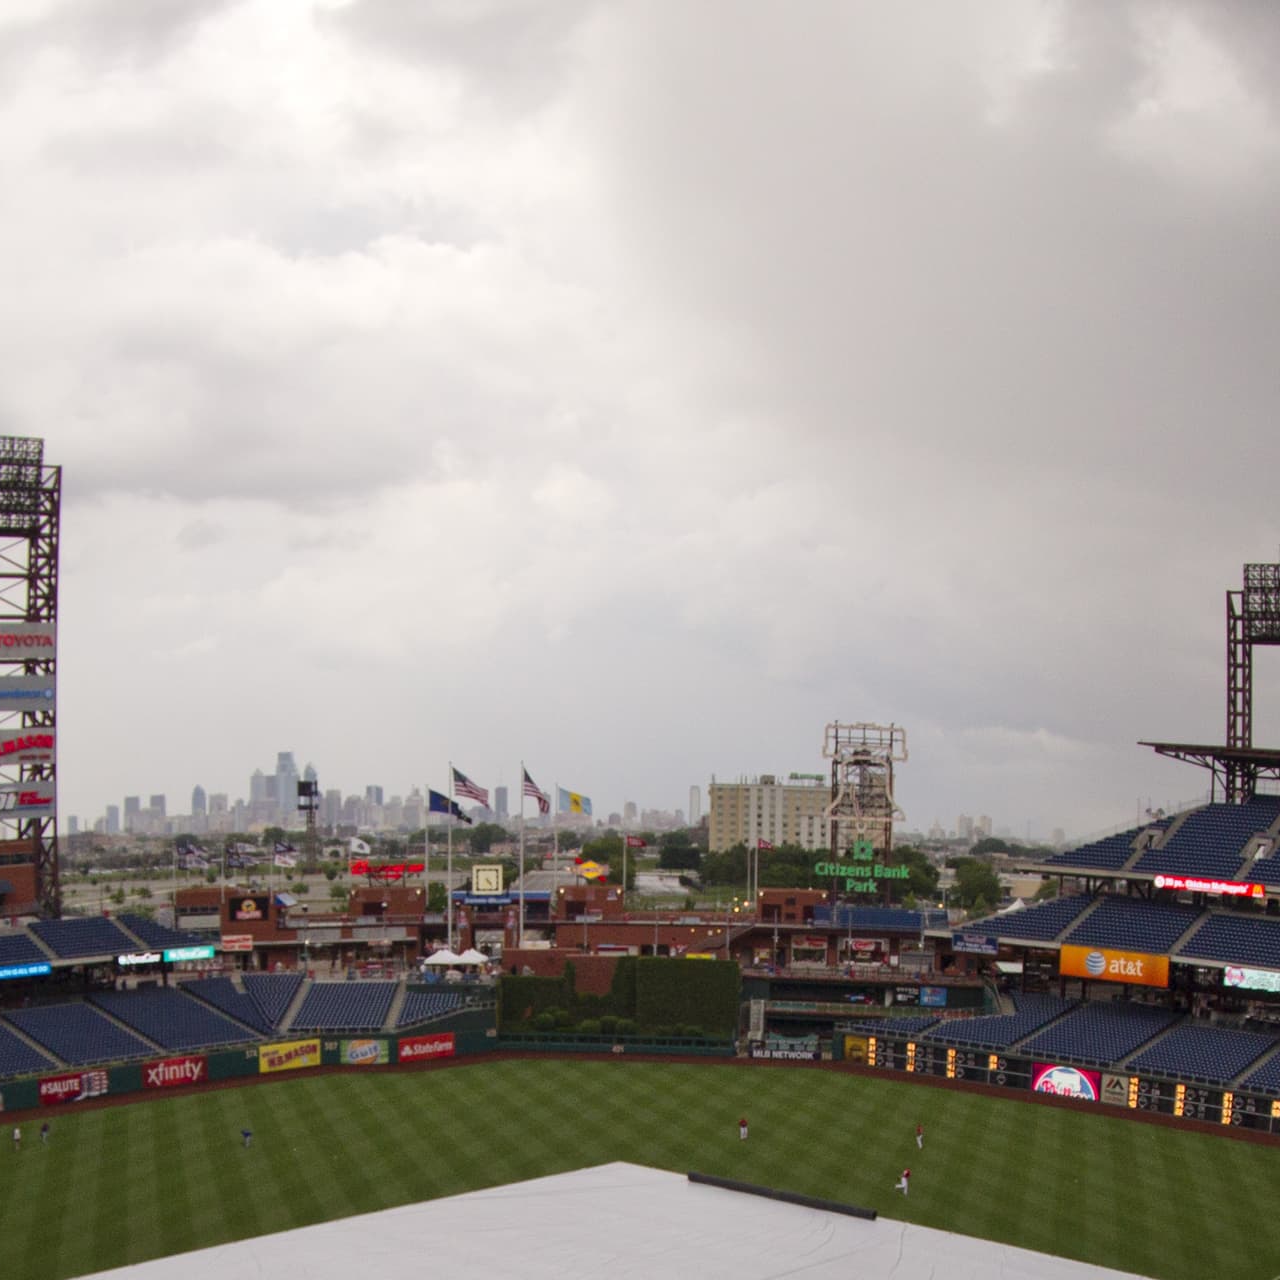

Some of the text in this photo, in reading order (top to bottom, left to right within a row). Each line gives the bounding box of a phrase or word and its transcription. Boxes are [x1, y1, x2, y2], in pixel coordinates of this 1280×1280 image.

[815, 862, 909, 879] Citizens Bank
[846, 879, 877, 893] Park
[1109, 957, 1143, 977] at&t
[350, 1045, 379, 1060] Gulf
[772, 1050, 815, 1060] NETWORK
[147, 1060, 203, 1085] xfinity
[1041, 1079, 1092, 1100] Phill
